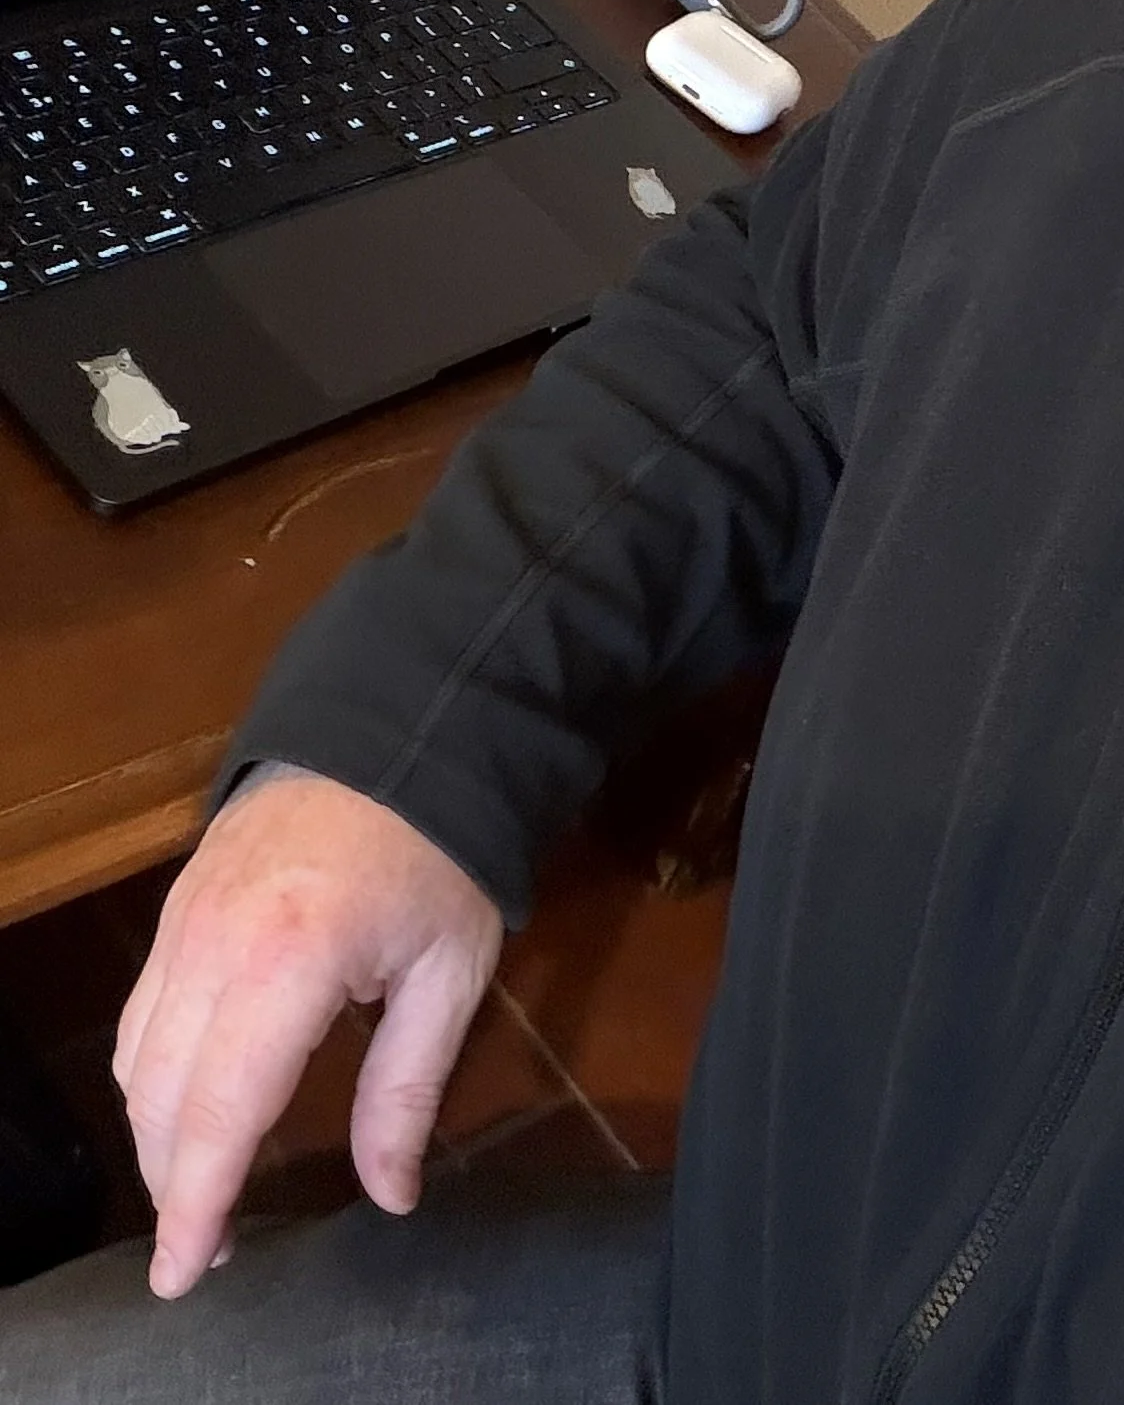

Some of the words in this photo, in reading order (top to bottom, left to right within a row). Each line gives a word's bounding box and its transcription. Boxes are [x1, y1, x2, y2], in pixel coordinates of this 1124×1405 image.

[24, 175, 39, 186] A
[72, 160, 87, 171] S
[338, 81, 354, 92] K
[379, 70, 394, 80] L
[26, 130, 45, 142] W
[77, 117, 93, 128] E
[124, 104, 140, 115] R
[169, 91, 183, 102] T
[214, 79, 227, 89] Y
[257, 66, 272, 77] U
[77, 200, 95, 212] Z
[125, 185, 143, 197] X
[173, 171, 189, 183] C
